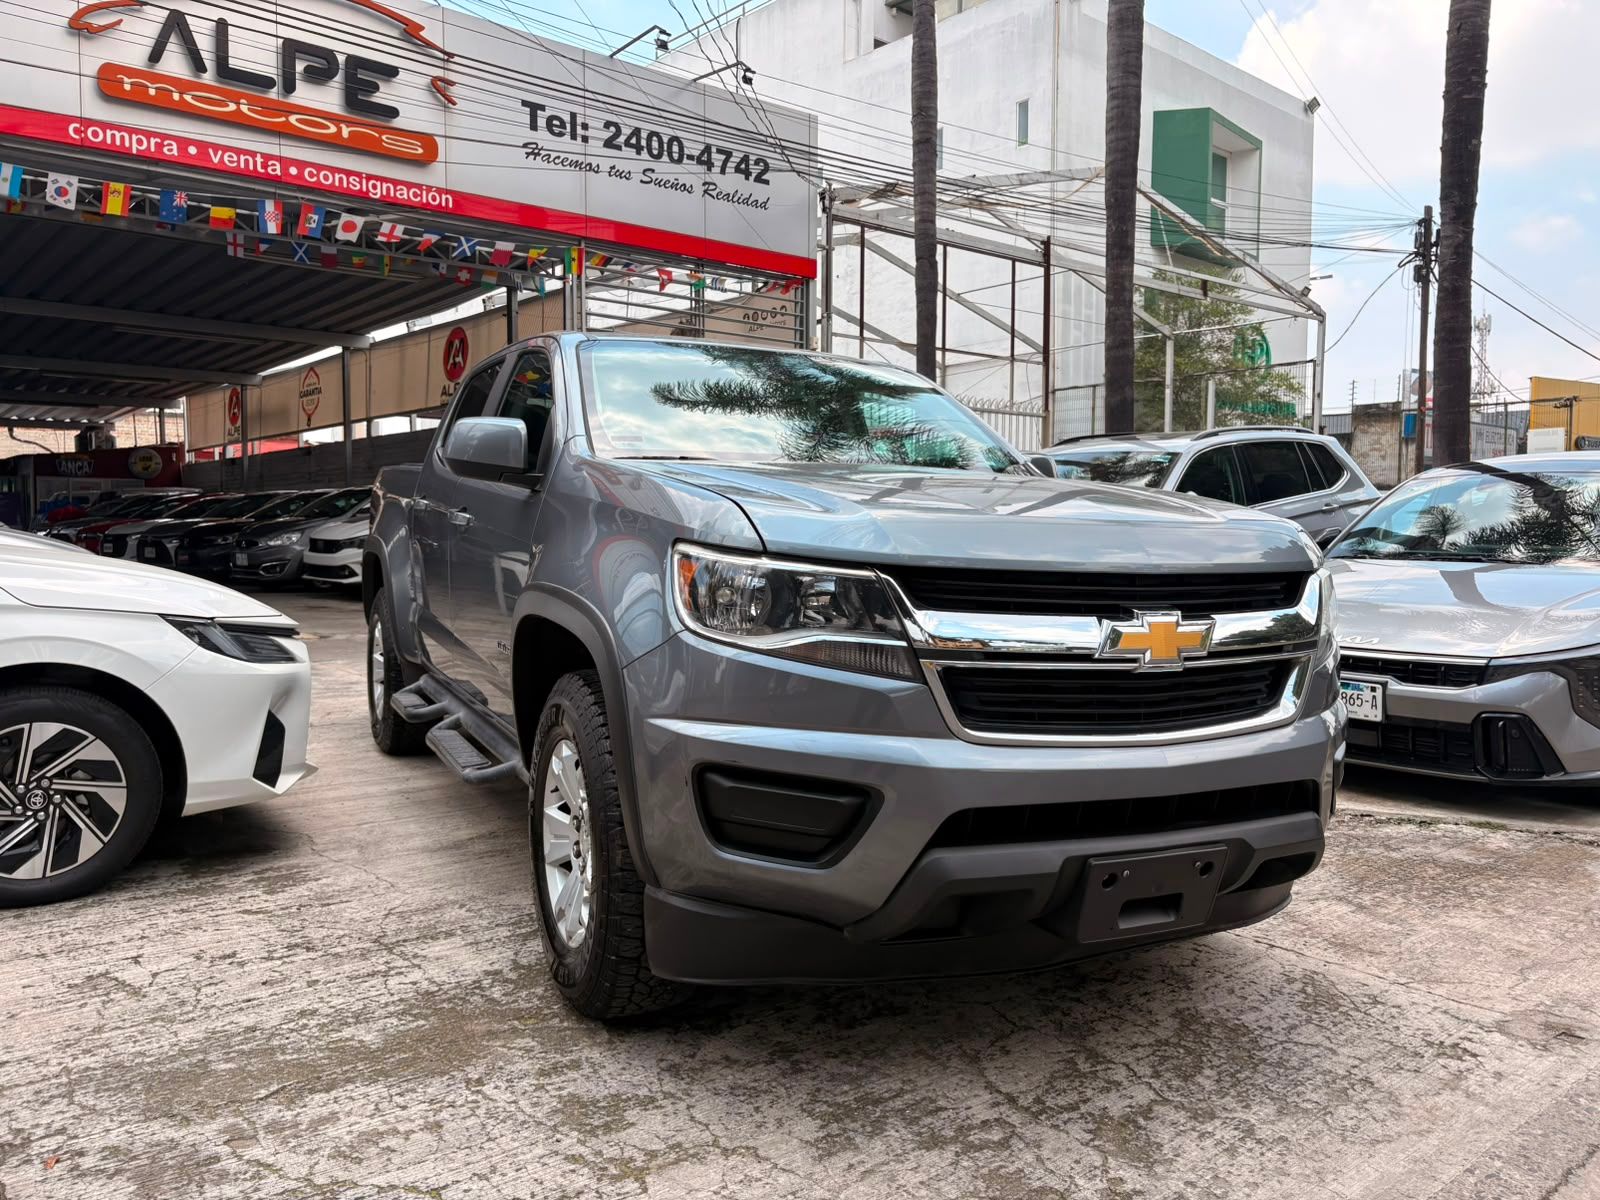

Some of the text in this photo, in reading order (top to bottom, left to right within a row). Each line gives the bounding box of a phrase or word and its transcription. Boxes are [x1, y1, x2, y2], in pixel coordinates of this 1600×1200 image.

[147, 9, 400, 119] ALPE
[116, 74, 424, 155] motors
[521, 99, 771, 186] Tel: 2400-4742
[68, 122, 454, 209] compra venta consignación
[521, 141, 771, 211] Hacemos tus Sueños Realidad
